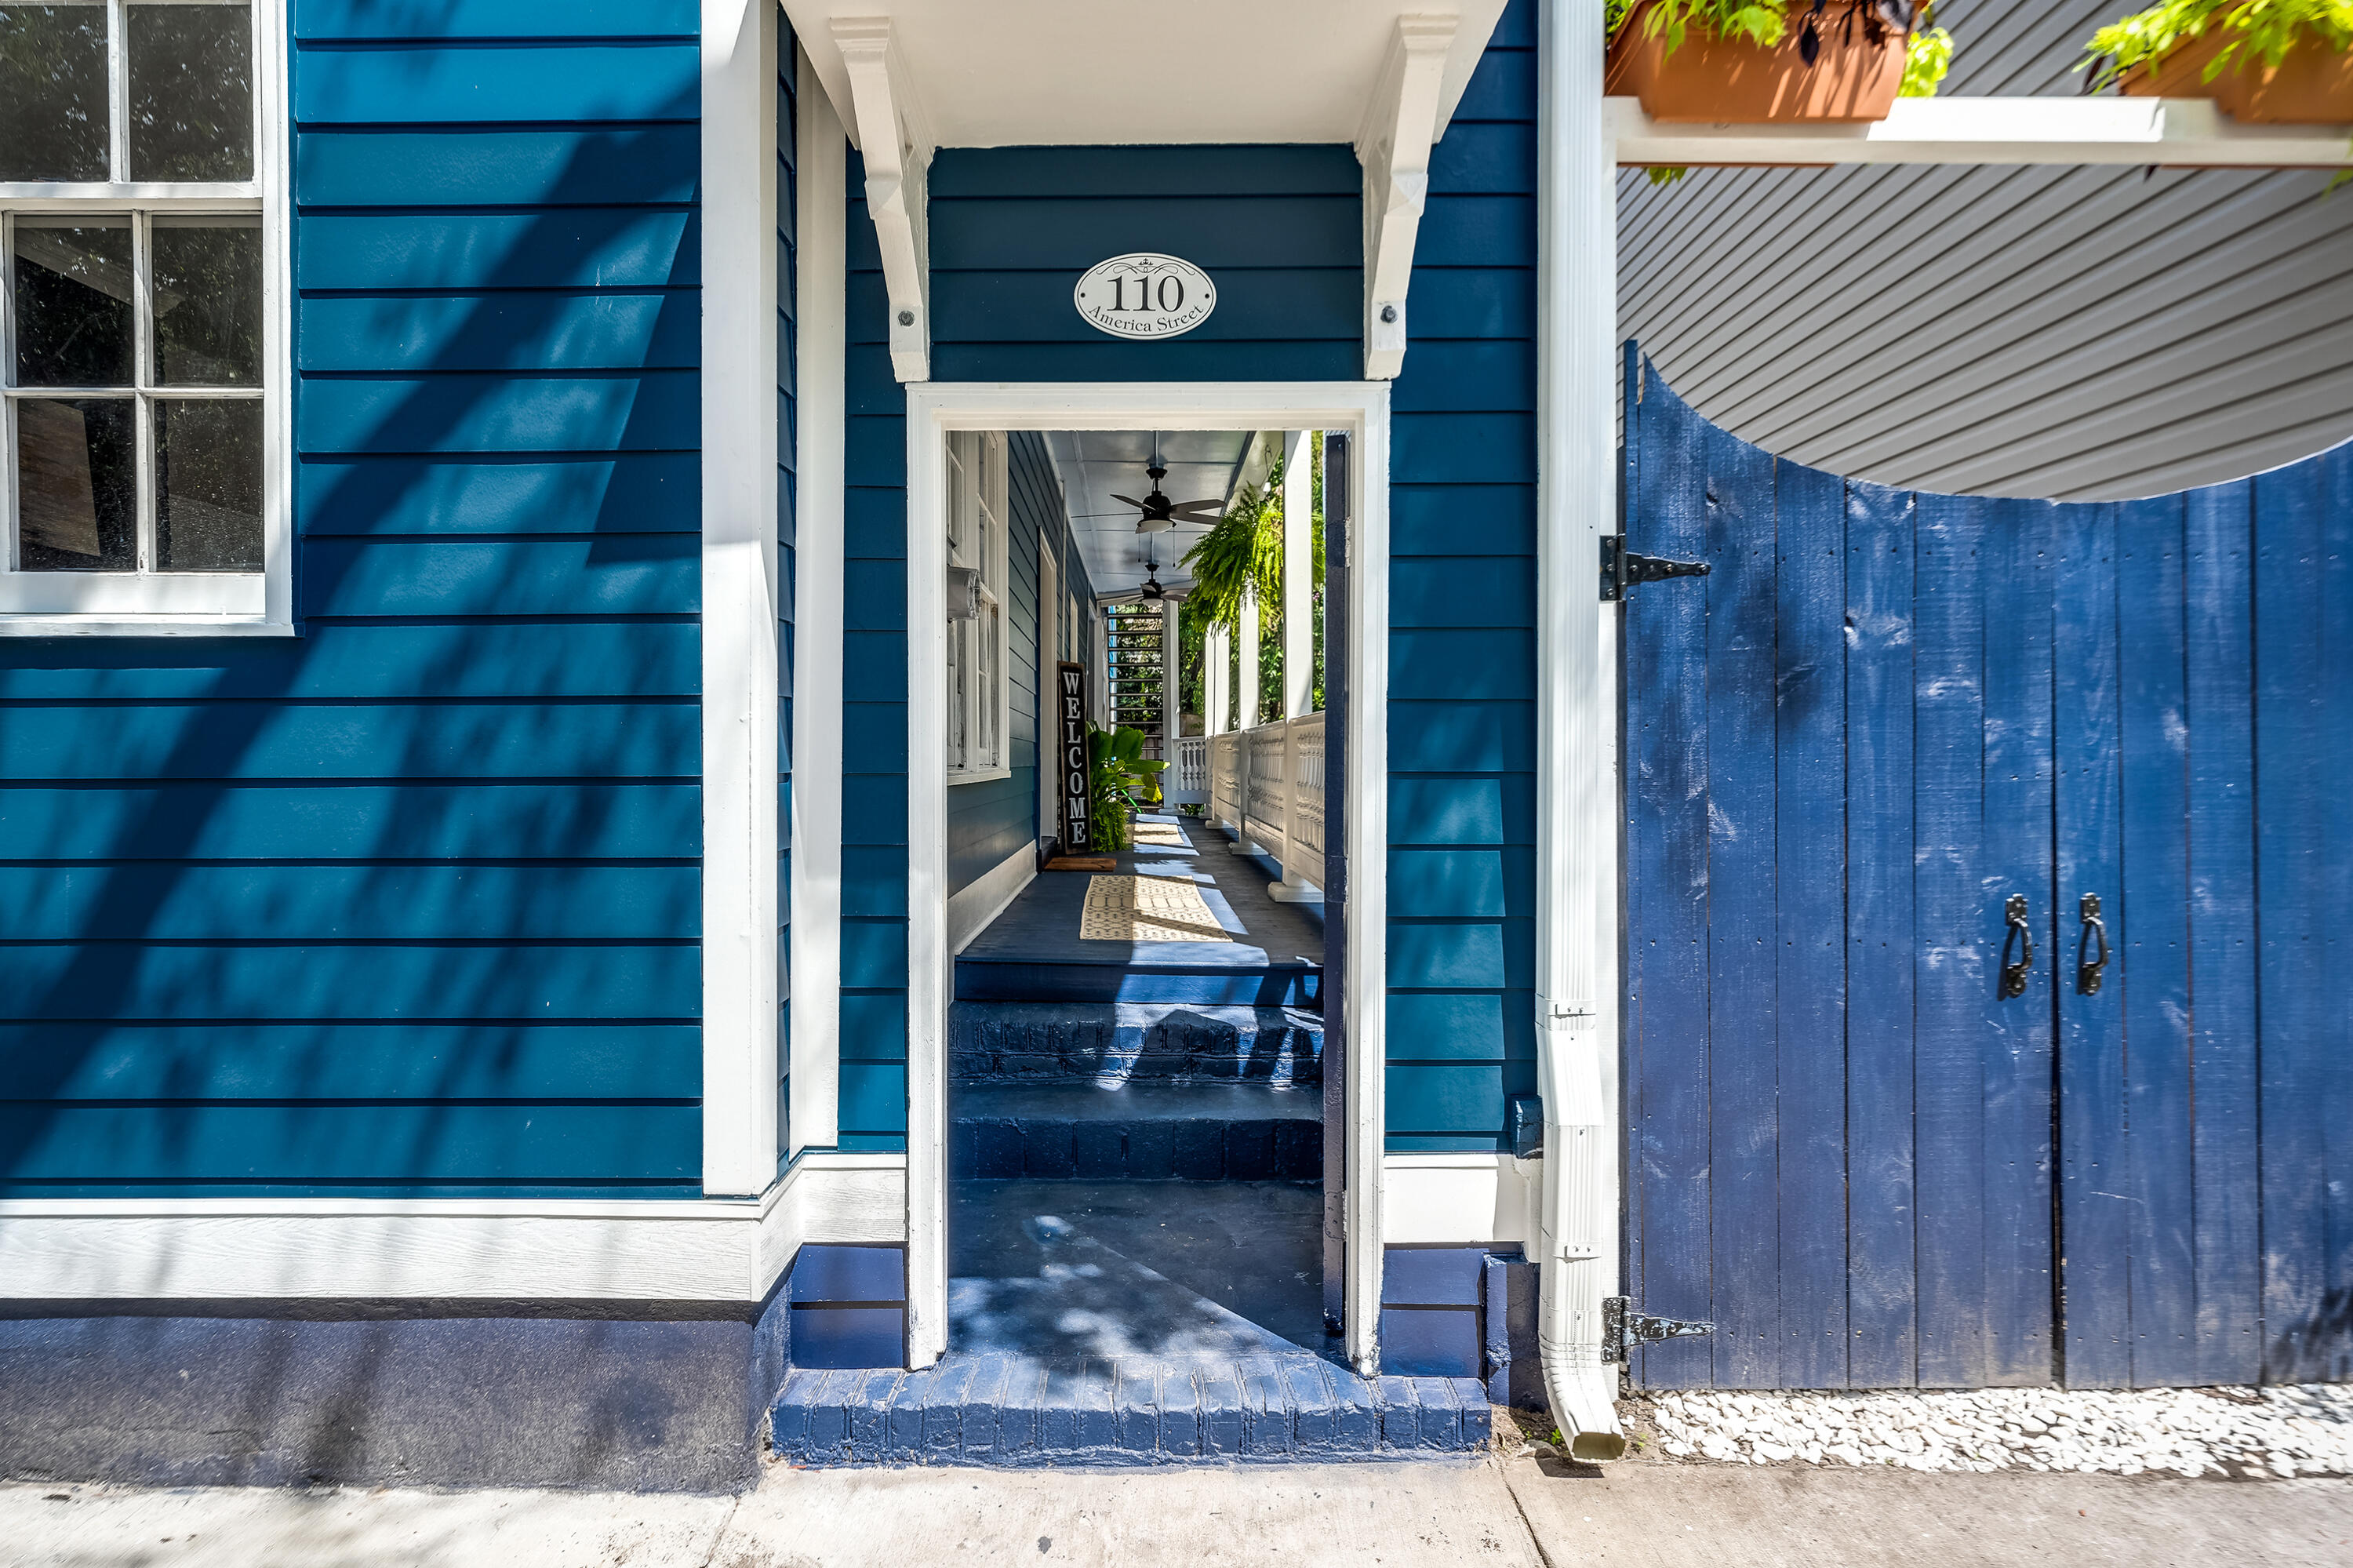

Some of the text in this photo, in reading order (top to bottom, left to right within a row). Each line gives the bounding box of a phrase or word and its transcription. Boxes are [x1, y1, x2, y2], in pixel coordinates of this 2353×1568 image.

[1107, 275, 1184, 313] 110
[1088, 304, 1204, 332] America Street
[1063, 671, 1086, 844] WELCOME
